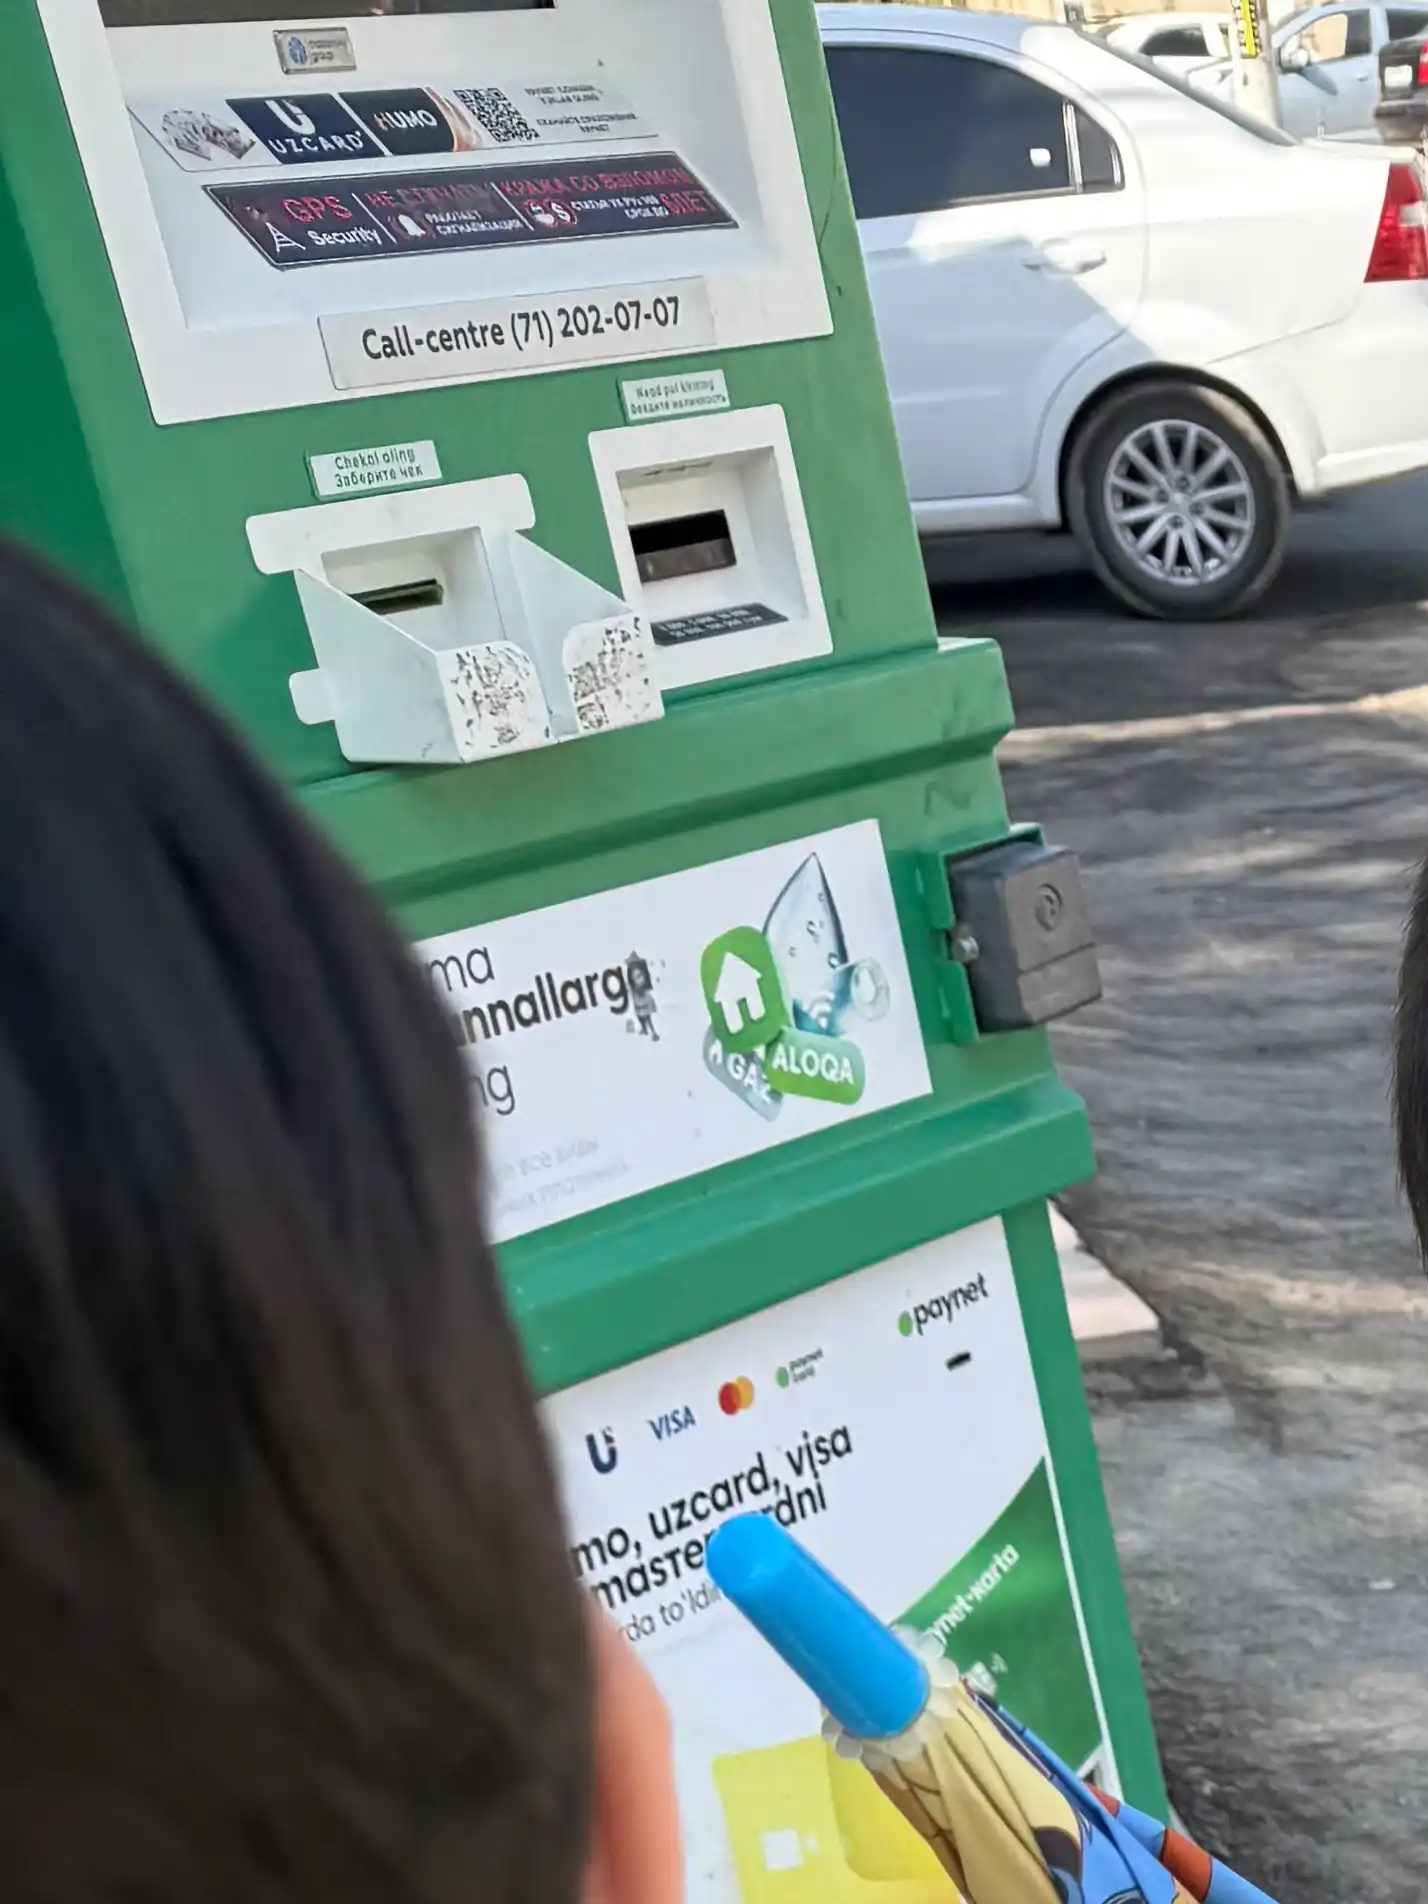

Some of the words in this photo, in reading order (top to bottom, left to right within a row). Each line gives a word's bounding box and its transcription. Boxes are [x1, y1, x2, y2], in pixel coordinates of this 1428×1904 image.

[373, 109, 438, 131] HUMO
[282, 195, 353, 222] GPS
[307, 226, 384, 246] Security
[362, 320, 504, 359] Call-centre
[511, 310, 553, 351] (71)
[557, 296, 680, 338] 202-07-07
[399, 464, 424, 479] чек
[427, 946, 496, 992] ma
[772, 1043, 855, 1085] ALOQA
[467, 1065, 516, 1116] ng
[913, 1271, 989, 1336] paynet
[647, 1404, 698, 1442] VISA
[570, 1526, 643, 1577] mo,
[648, 1451, 781, 1541] uzcard,
[786, 1425, 853, 1479] visa
